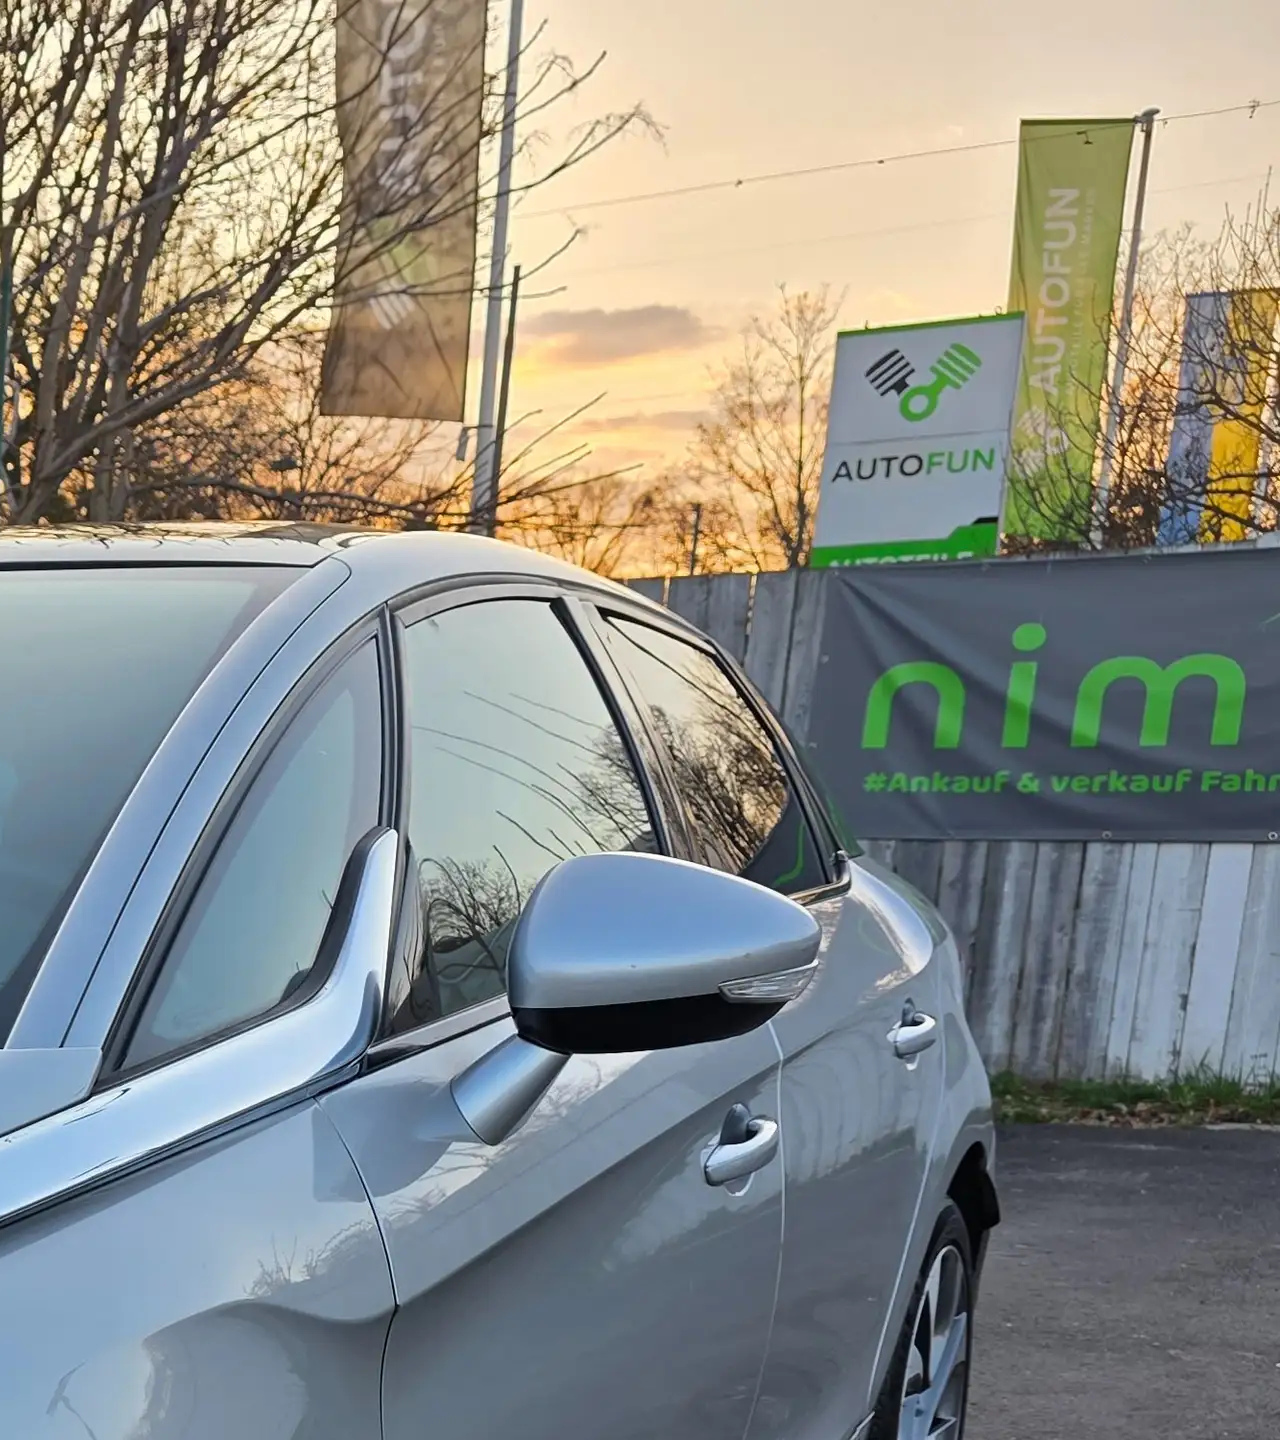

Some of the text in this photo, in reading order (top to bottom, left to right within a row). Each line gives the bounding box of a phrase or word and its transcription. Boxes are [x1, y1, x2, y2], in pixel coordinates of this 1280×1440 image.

[1028, 188, 1081, 397] AUTOFUN
[831, 447, 995, 483] AUTOFUN
[861, 622, 1247, 749] nim
[863, 769, 1011, 793] #Ankauf
[1016, 770, 1040, 793] &
[1050, 768, 1192, 793] verkauf
